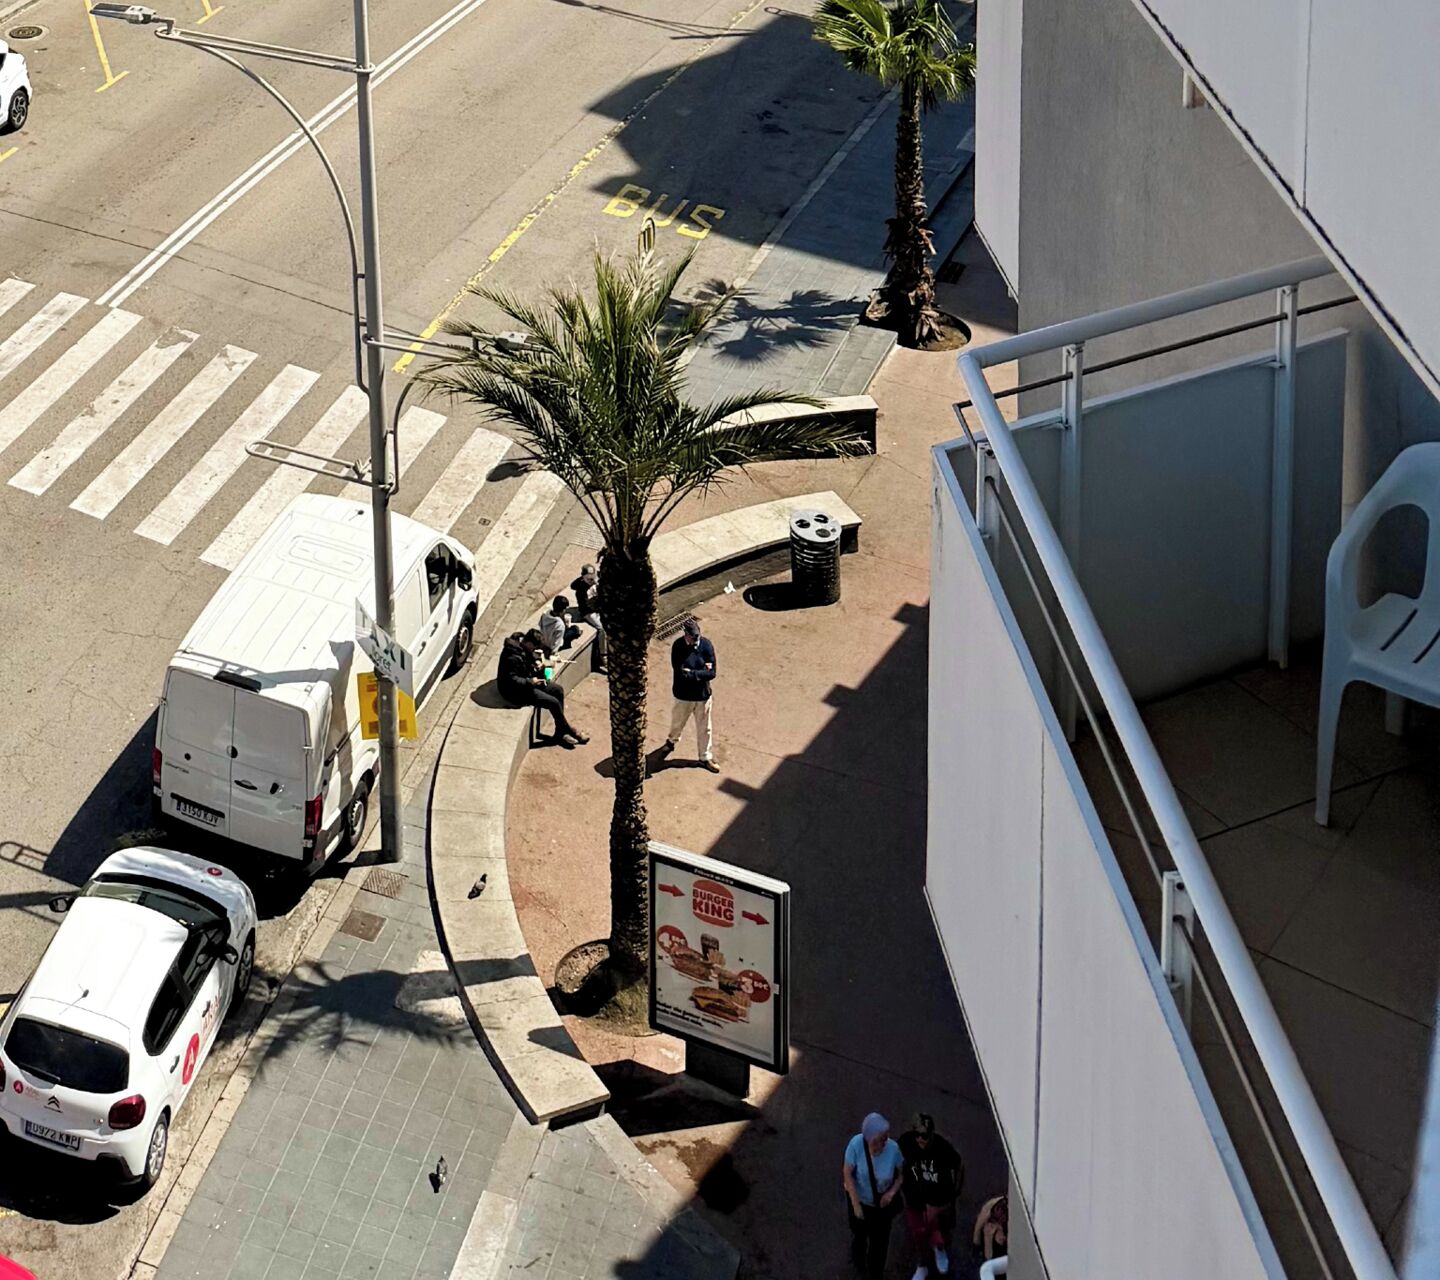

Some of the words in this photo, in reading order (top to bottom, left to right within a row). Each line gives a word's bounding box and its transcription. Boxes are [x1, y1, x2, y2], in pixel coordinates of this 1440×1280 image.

[600, 182, 726, 241] BUS
[359, 607, 406, 671] TAXI
[692, 888, 734, 909] BURGER
[692, 899, 734, 922] KING
[32, 1123, 57, 1140] 0972
